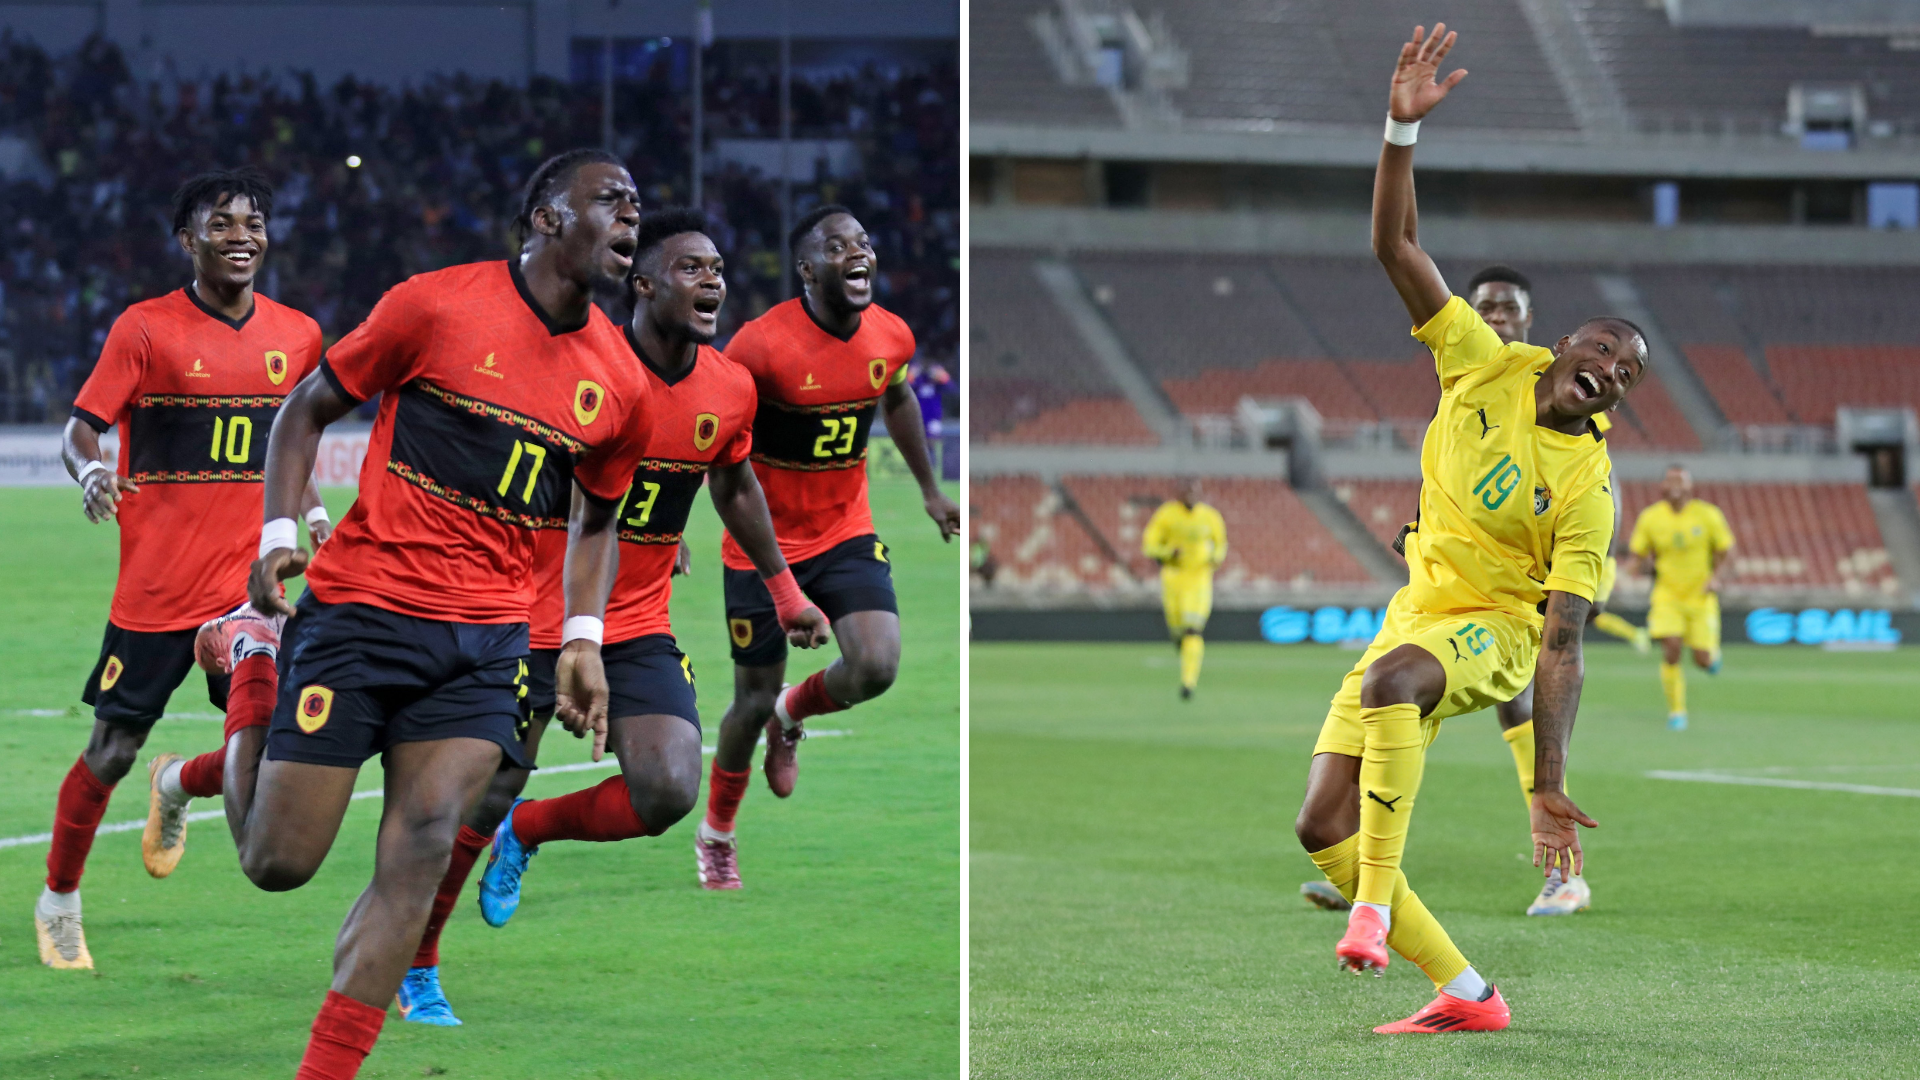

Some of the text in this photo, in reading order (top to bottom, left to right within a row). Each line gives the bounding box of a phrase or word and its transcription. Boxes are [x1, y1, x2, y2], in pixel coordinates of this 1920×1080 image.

[210, 415, 252, 463] 10
[813, 416, 858, 457] 23
[497, 439, 546, 505] 17
[1472, 453, 1521, 510] 19
[1456, 622, 1495, 656] 19
[1795, 608, 1902, 645] SAIL
